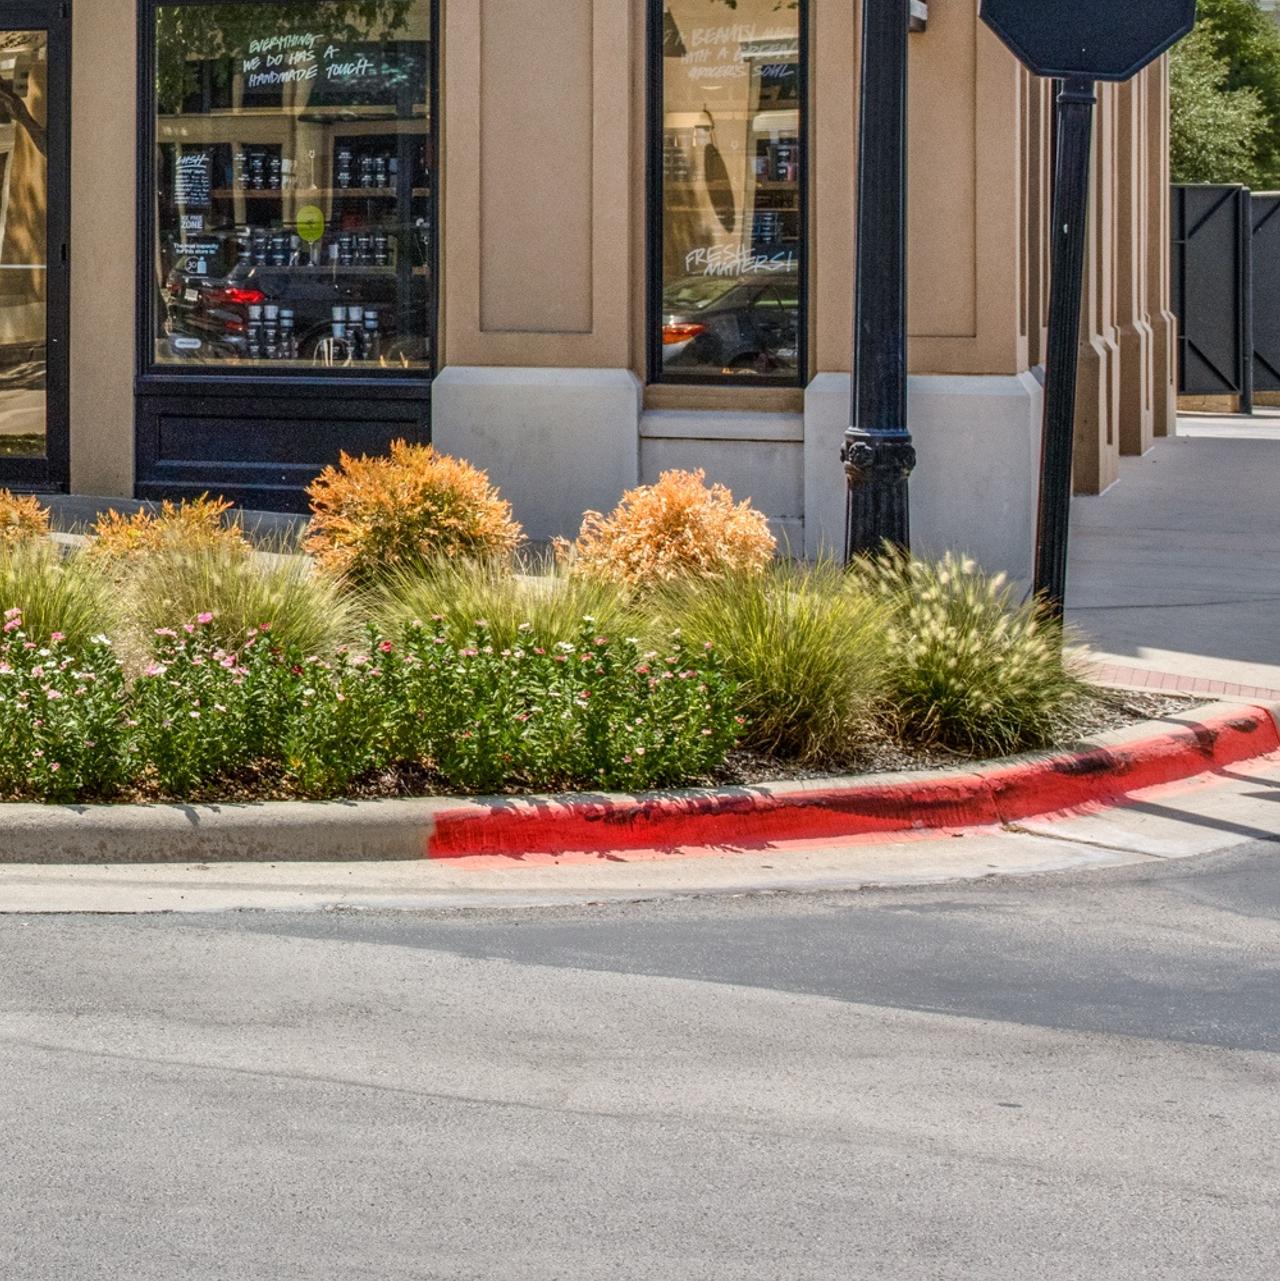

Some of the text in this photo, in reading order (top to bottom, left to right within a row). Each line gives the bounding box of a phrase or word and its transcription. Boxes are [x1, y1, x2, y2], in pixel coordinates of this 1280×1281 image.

[249, 32, 324, 53] EVERYTHING
[243, 45, 340, 72] WE DO HAS A
[752, 64, 795, 78] SOUL
[248, 57, 374, 87] HANDMADE TOUCH
[685, 243, 755, 272] FRESH
[704, 251, 792, 277] MATTERS!
